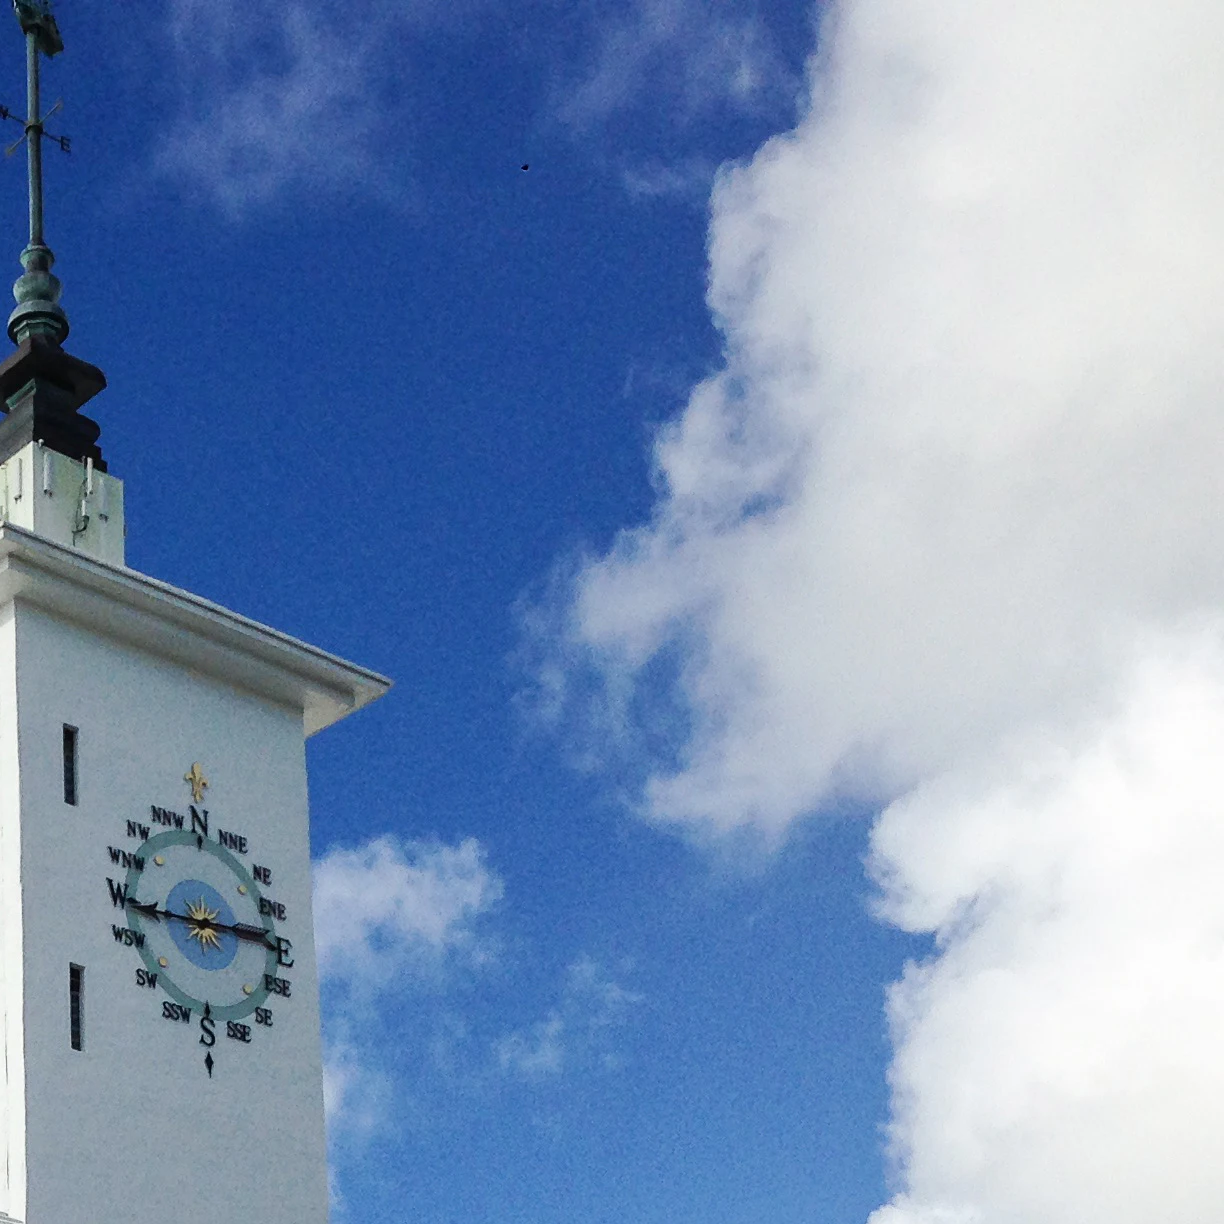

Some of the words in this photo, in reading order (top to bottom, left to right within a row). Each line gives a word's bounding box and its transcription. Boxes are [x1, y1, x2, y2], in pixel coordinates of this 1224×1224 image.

[151, 805, 184, 830] NNW
[188, 805, 208, 837] N
[126, 819, 150, 841] NW
[218, 829, 248, 854] NNE
[107, 846, 145, 872] WNW
[252, 864, 272, 887] NE
[106, 877, 130, 910] W
[259, 897, 286, 921] ENE
[111, 924, 145, 949] WSW
[275, 936, 294, 968] E
[136, 968, 158, 989] SW
[264, 974, 291, 998] ESE
[162, 1001, 192, 1024] SSW
[255, 1006, 273, 1028] SE
[200, 1017, 216, 1047] S
[226, 1020, 251, 1044] SSE
